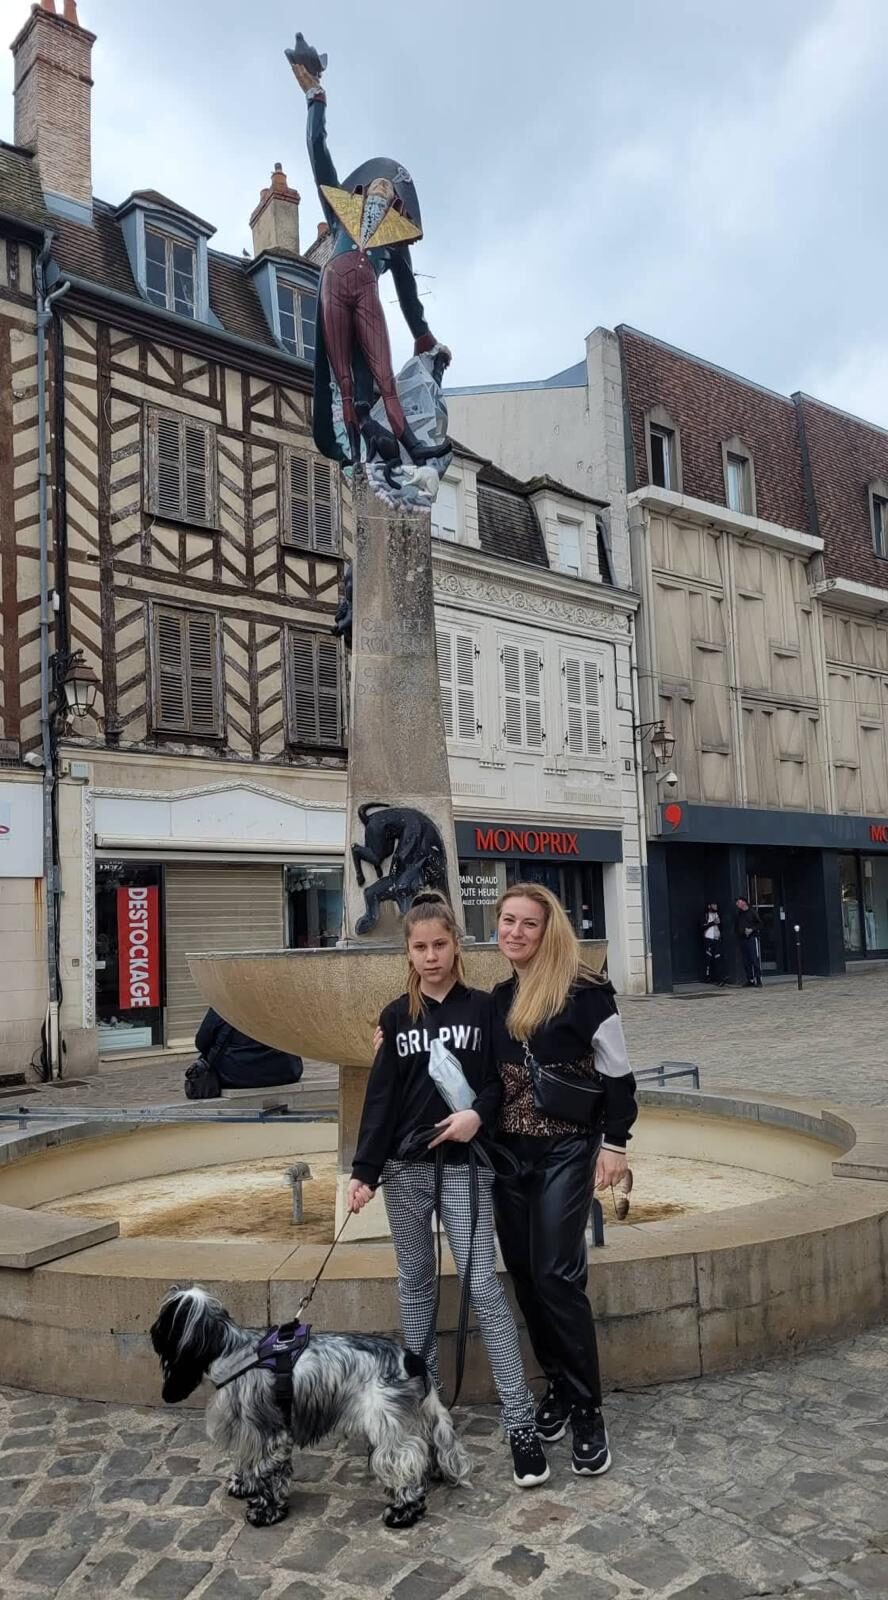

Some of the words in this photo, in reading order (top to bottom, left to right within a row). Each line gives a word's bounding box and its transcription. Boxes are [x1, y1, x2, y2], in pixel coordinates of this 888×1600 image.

[476, 828, 580, 854] MONOPRIX
[459, 887, 476, 896] OUTE
[478, 887, 499, 896] HEURE
[475, 876, 498, 885] CHAUD
[128, 888, 151, 1008] DESTOCKAGE
[396, 1028, 431, 1057] GRL
